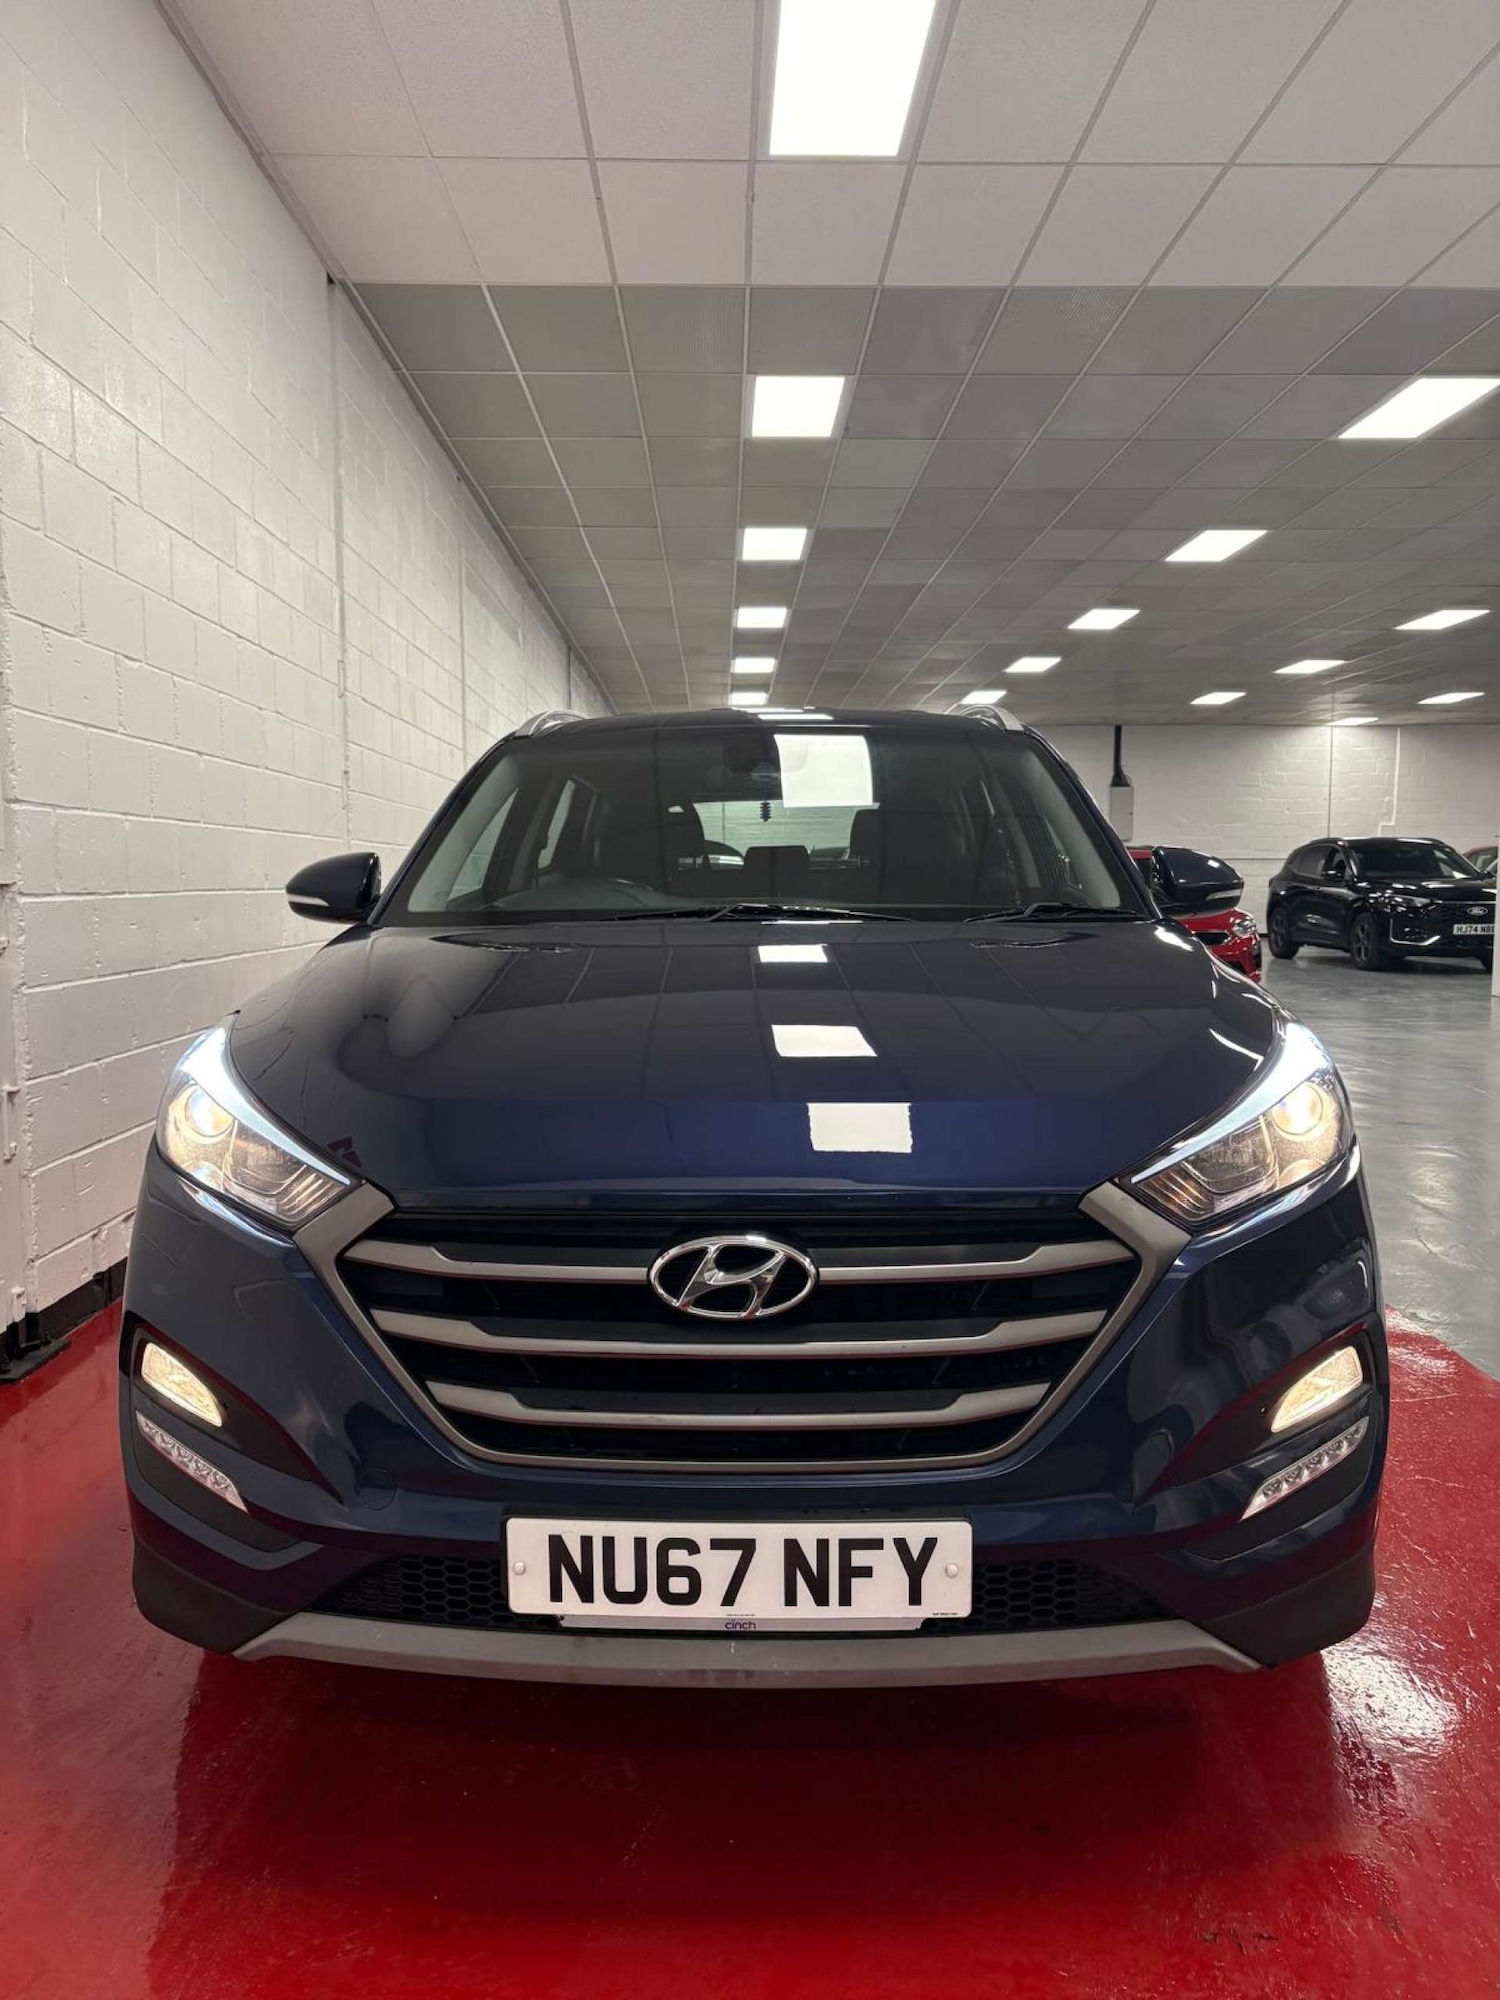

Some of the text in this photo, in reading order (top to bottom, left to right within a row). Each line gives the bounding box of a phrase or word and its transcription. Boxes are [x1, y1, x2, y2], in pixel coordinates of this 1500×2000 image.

[548, 1534, 938, 1607] NU67 NFY
[724, 1619, 757, 1630] cinch
